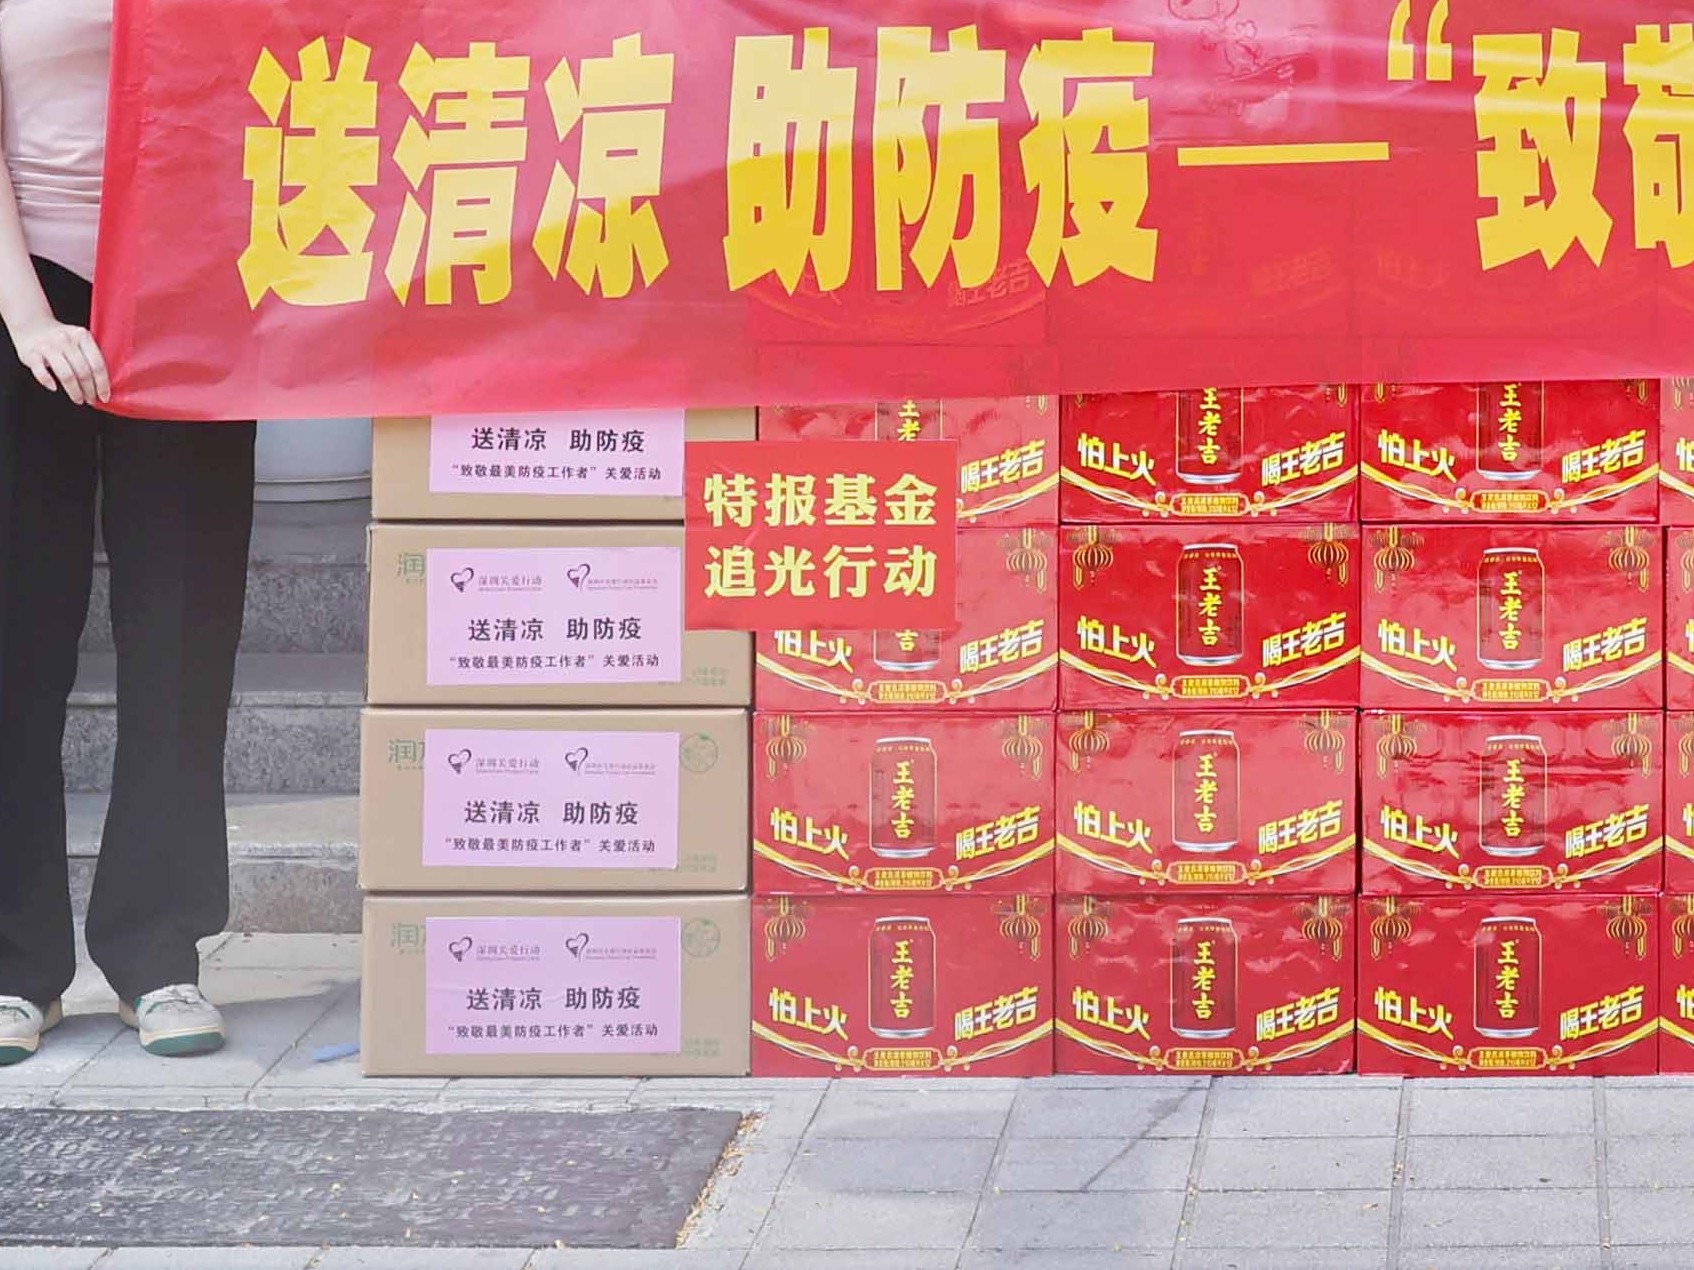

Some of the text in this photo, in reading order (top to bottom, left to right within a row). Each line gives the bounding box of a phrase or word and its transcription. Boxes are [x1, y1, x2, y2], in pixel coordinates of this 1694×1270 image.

[238, 35, 673, 309] 送清凉
[471, 427, 645, 453] 送清凉 助防疫
[1198, 386, 1223, 465] 王老吉
[605, 466, 661, 481] 关爱活动
[1077, 432, 1156, 484] 怕上火
[1261, 431, 1345, 487] 喝王老吉
[704, 473, 937, 527] 特报基金
[704, 545, 937, 598] 追光行动
[468, 616, 642, 642] 送清凉 助防疫
[1499, 571, 1524, 650] 王老吉
[603, 654, 659, 668] 关爱活动
[775, 620, 854, 672] 怕上火
[960, 618, 1044, 674] 喝王老吉
[1378, 618, 1457, 670] 怕上火
[1563, 616, 1647, 672] 喝王老吉
[464, 800, 639, 825] 送清凉 助防疫
[1194, 754, 1219, 833] 王老吉
[598, 839, 656, 852] 关爱活动
[1074, 800, 1153, 852] 怕上火
[1258, 799, 1342, 855] 喝王老吉
[466, 986, 641, 1011] 送清凉 助防疫
[890, 940, 915, 1019] 王老吉
[1496, 940, 1521, 1019] 王老吉
[602, 1023, 658, 1037] 关爱活动
[769, 987, 848, 1039] 怕上火
[954, 985, 1038, 1041] 喝王老吉
[1375, 986, 1454, 1038] 怕上火
[1560, 985, 1644, 1041] 喝王老吉
